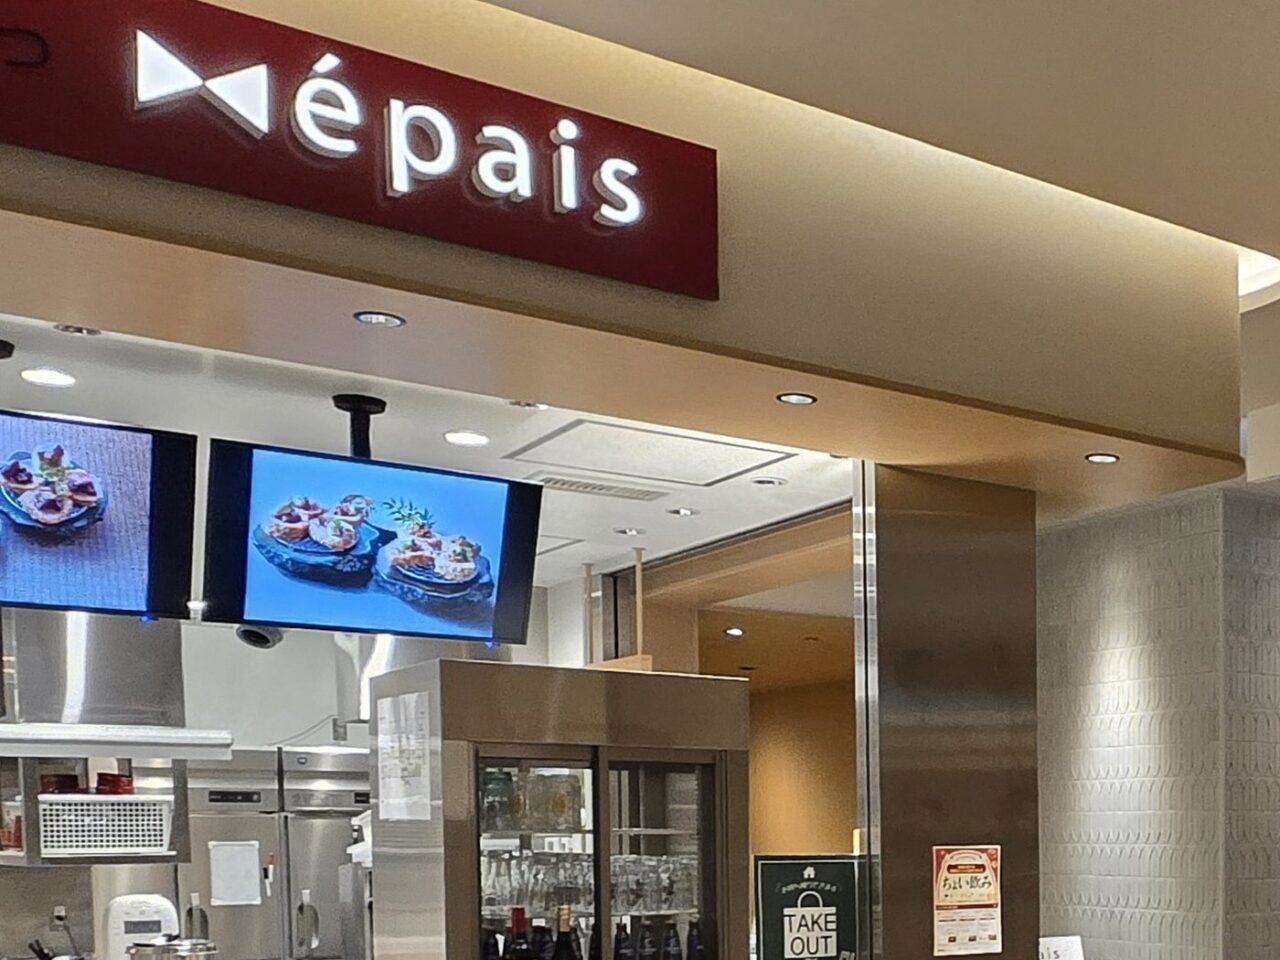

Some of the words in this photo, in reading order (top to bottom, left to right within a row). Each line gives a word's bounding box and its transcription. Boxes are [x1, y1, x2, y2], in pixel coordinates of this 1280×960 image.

[292, 52, 644, 227] épais
[942, 875, 992, 890] ちょい飲み
[783, 913, 837, 933] TAKE
[790, 935, 832, 956] OUT
